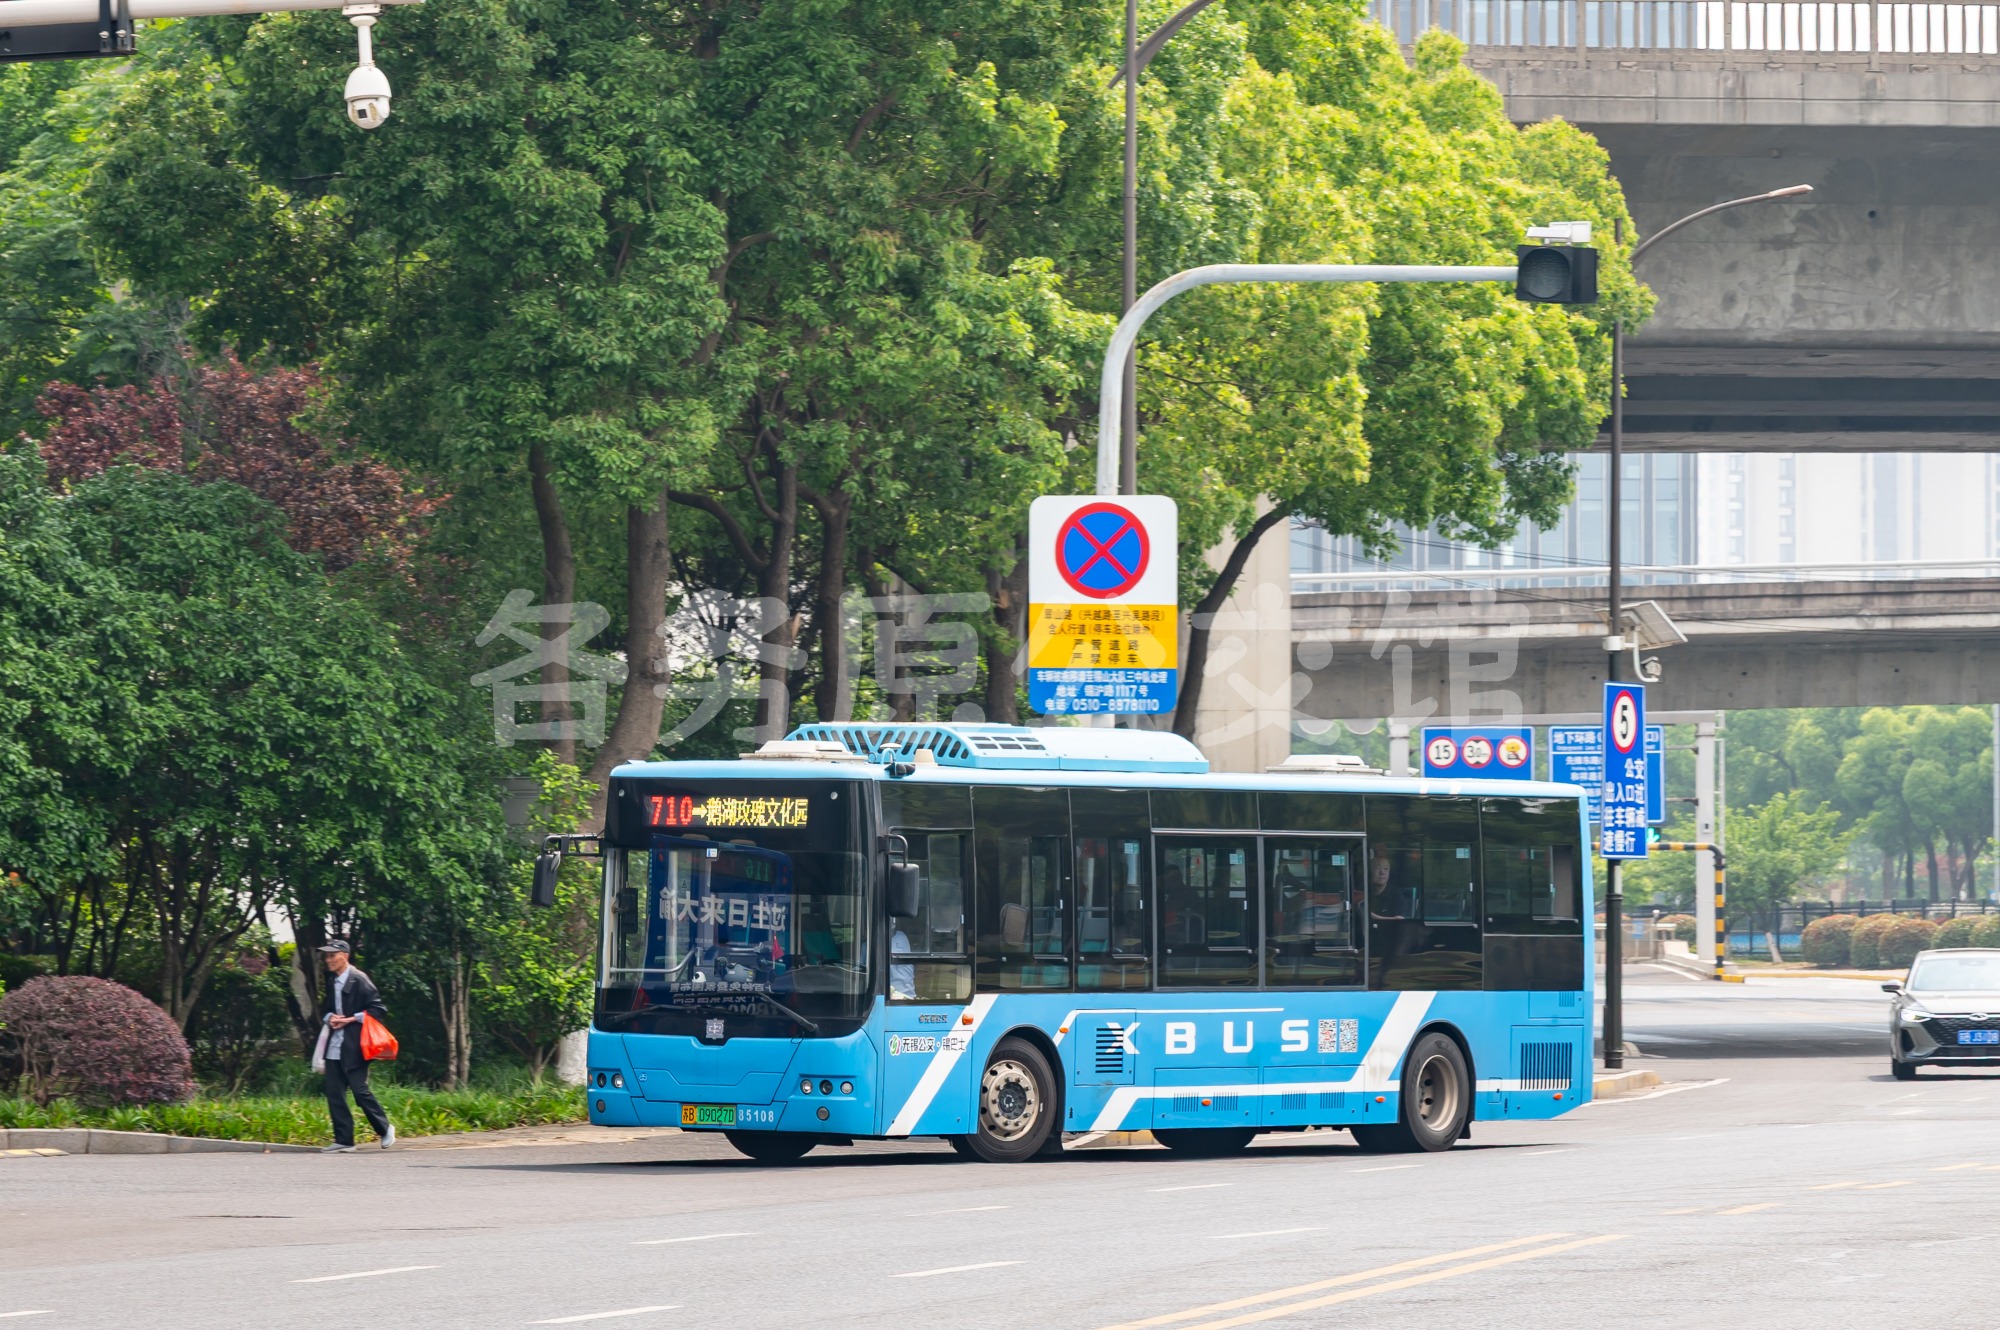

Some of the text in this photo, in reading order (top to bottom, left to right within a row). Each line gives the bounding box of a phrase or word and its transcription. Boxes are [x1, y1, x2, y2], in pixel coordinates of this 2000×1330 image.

[1620, 704, 1629, 740] 5
[1434, 744, 1451, 760] 15
[1624, 757, 1645, 780] 公交
[1604, 781, 1646, 805] 出入口过
[651, 796, 809, 827] 710 鹅湖玫瑰文化园
[1602, 829, 1637, 853] 速慢行
[738, 1109, 774, 1123] 85108
